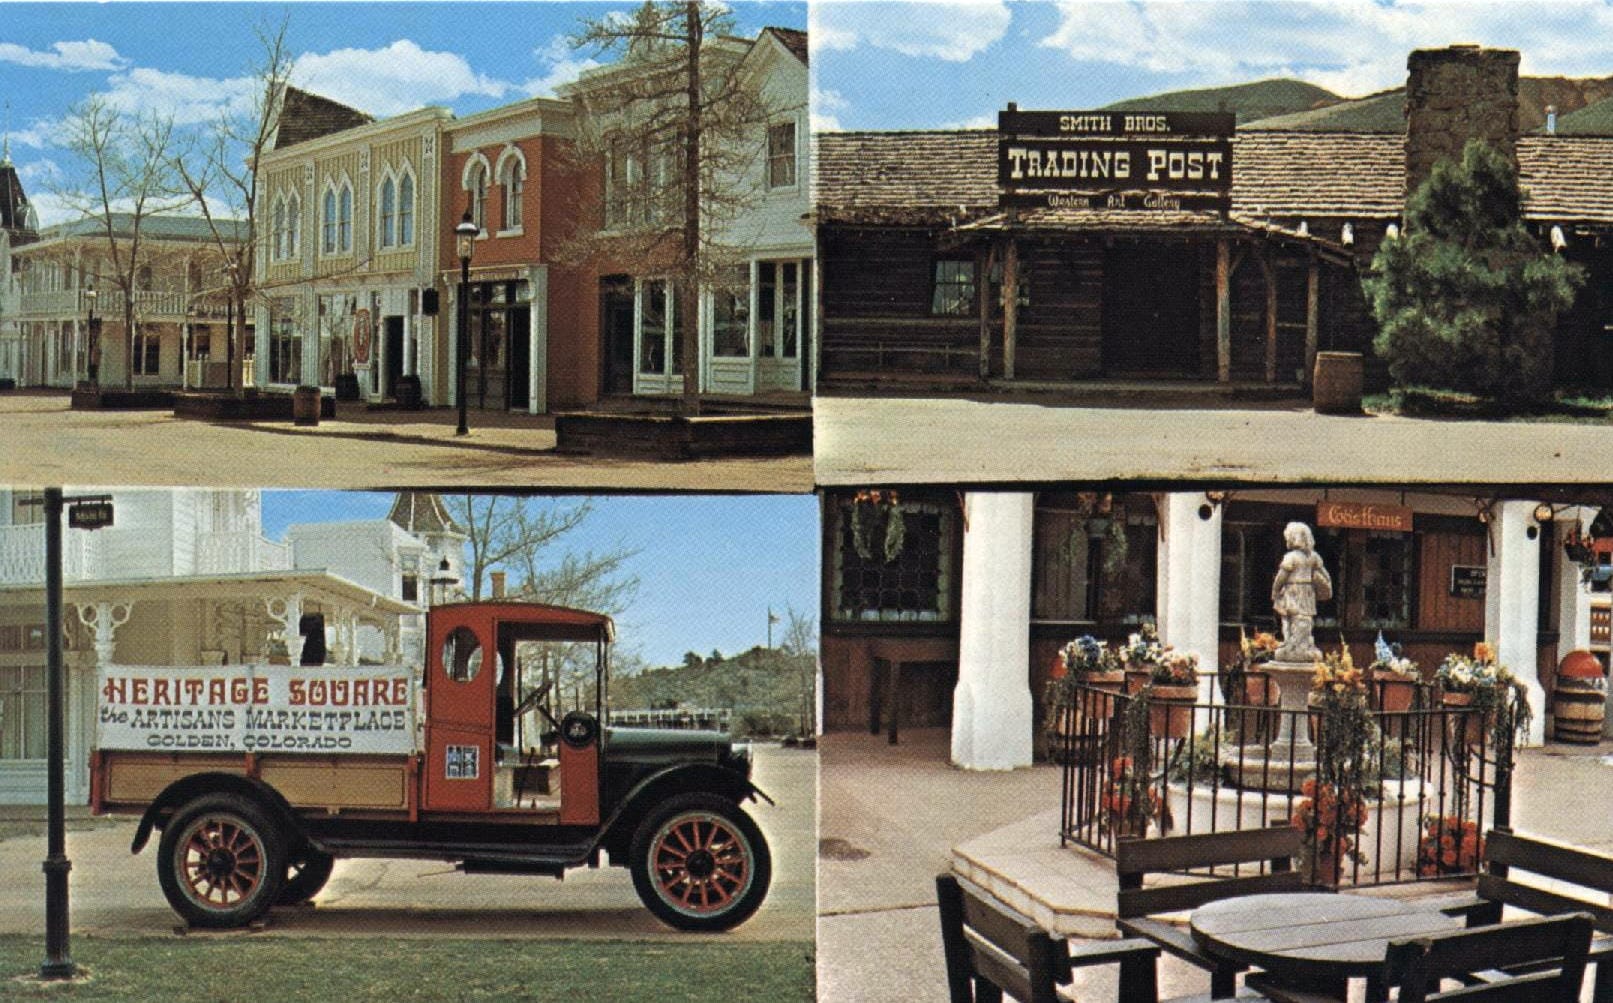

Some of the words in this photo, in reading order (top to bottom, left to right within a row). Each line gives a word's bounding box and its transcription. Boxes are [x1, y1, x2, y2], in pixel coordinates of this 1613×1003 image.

[1059, 116, 1112, 132] SMITH
[1124, 116, 1171, 132] BROS.
[1008, 148, 1131, 179] TRADING
[1147, 150, 1223, 181] POST
[1107, 194, 1126, 208] Art
[1143, 194, 1181, 210] Gallery
[103, 677, 268, 705] HERITAGE
[288, 678, 408, 706] SQUARE
[101, 706, 128, 723] the
[131, 709, 235, 730] ARTISANS
[246, 708, 406, 731] MARKETPLACE
[147, 734, 236, 750] GOLDEN,
[243, 734, 352, 748] COLORADO
